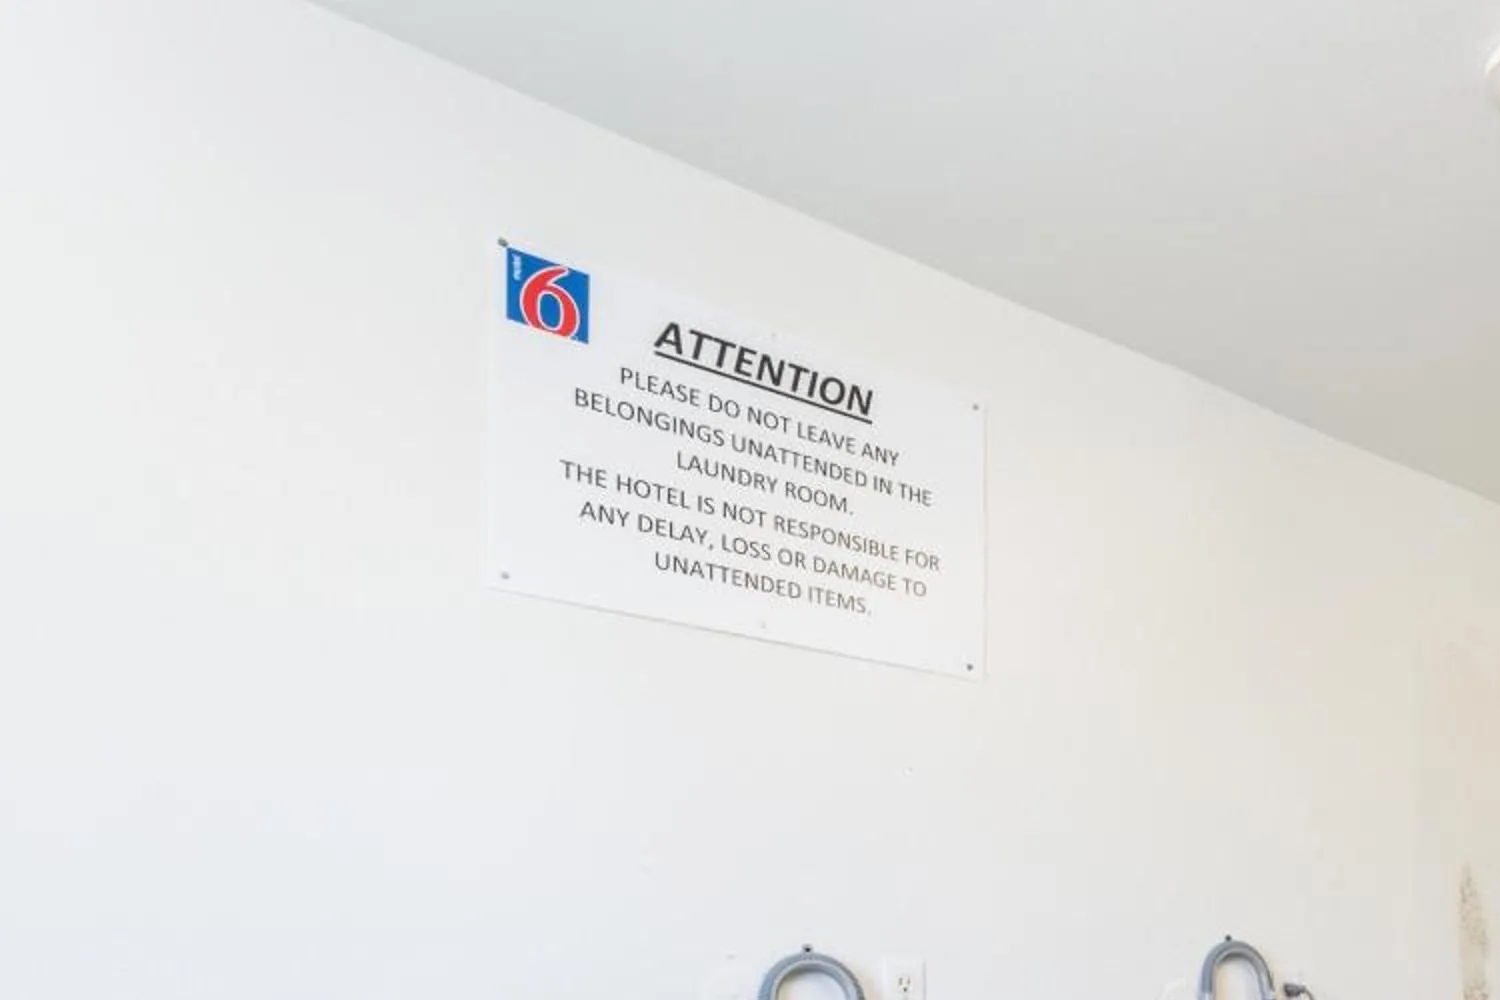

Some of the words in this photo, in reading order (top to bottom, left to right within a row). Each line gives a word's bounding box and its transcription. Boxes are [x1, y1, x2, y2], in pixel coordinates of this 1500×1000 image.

[520, 265, 580, 338] 6
[620, 367, 700, 407] PLEASE
[708, 393, 741, 419] DO
[747, 406, 791, 434] NOT
[797, 421, 856, 455] LEAVE
[861, 442, 900, 467] ANY
[653, 321, 873, 417] ATTENTION
[575, 387, 725, 448] BELONGINGS
[731, 433, 868, 488] UNATTENDED
[873, 475, 893, 496] IN
[898, 482, 933, 507] THE
[677, 450, 778, 494] LAUNDRY
[785, 481, 854, 516] ROOM.
[559, 459, 608, 489] THE
[616, 473, 691, 510] HOTEL
[697, 495, 715, 515] IS
[722, 501, 767, 528] NOT
[774, 514, 900, 562] RESPONSIBLE
[905, 548, 940, 572] FOR
[579, 501, 630, 527] ANY
[637, 513, 715, 551] DELAY,
[721, 533, 772, 562] LOSS
[777, 548, 806, 571] OR
[813, 555, 897, 592] DAMAGE
[901, 577, 927, 598] TO
[655, 551, 802, 599] UNATTENDED
[808, 586, 873, 616] ITEMS.
